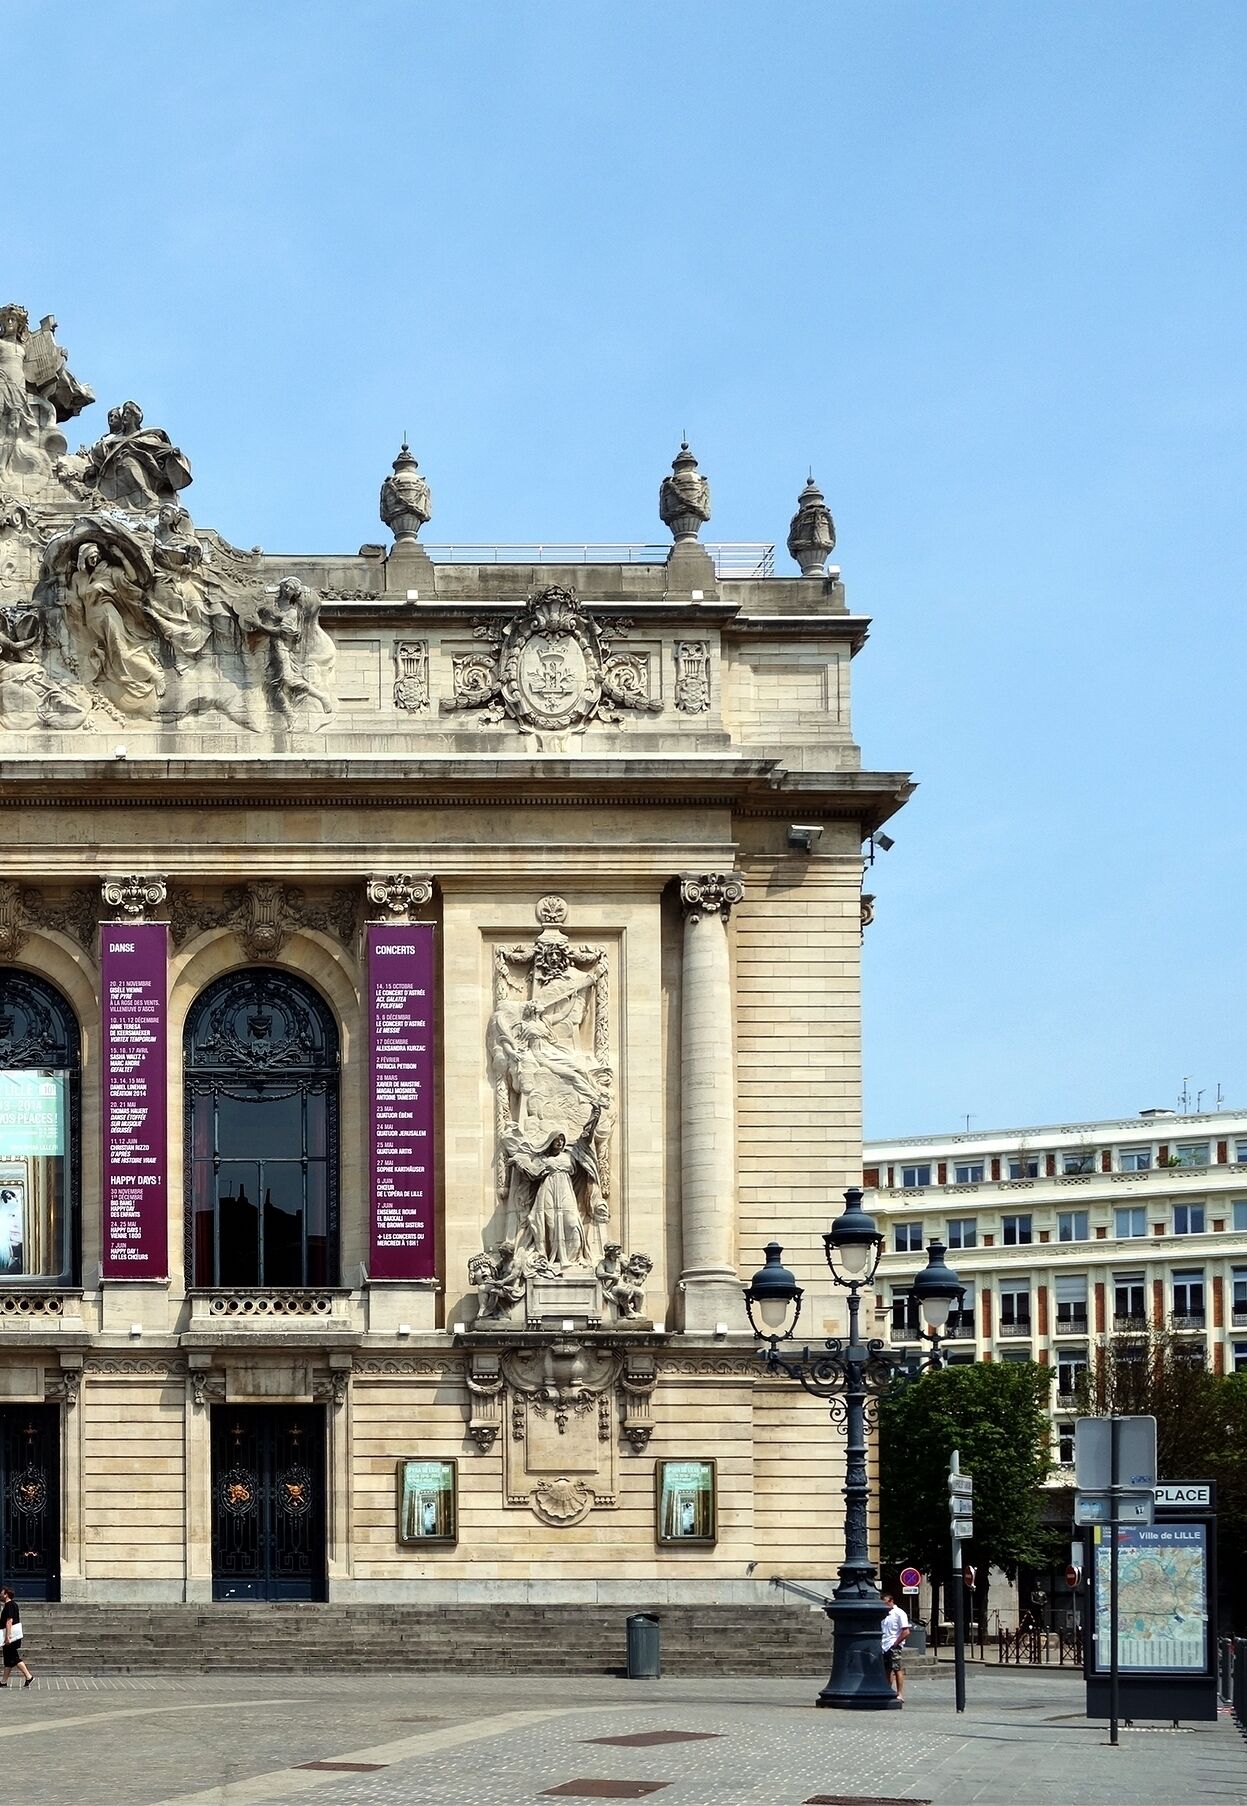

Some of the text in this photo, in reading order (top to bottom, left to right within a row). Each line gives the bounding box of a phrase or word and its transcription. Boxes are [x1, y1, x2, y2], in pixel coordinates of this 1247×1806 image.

[109, 943, 135, 953] DANSE
[376, 945, 415, 955] CONCERTS
[382, 988, 403, 996] CONCERT
[382, 1019, 404, 1027] CONCERT
[17, 1113, 53, 1124] PLACES
[111, 1175, 136, 1185] HAPPY
[138, 1175, 157, 1185] DAYS
[1155, 1490, 1207, 1501] PLACE
